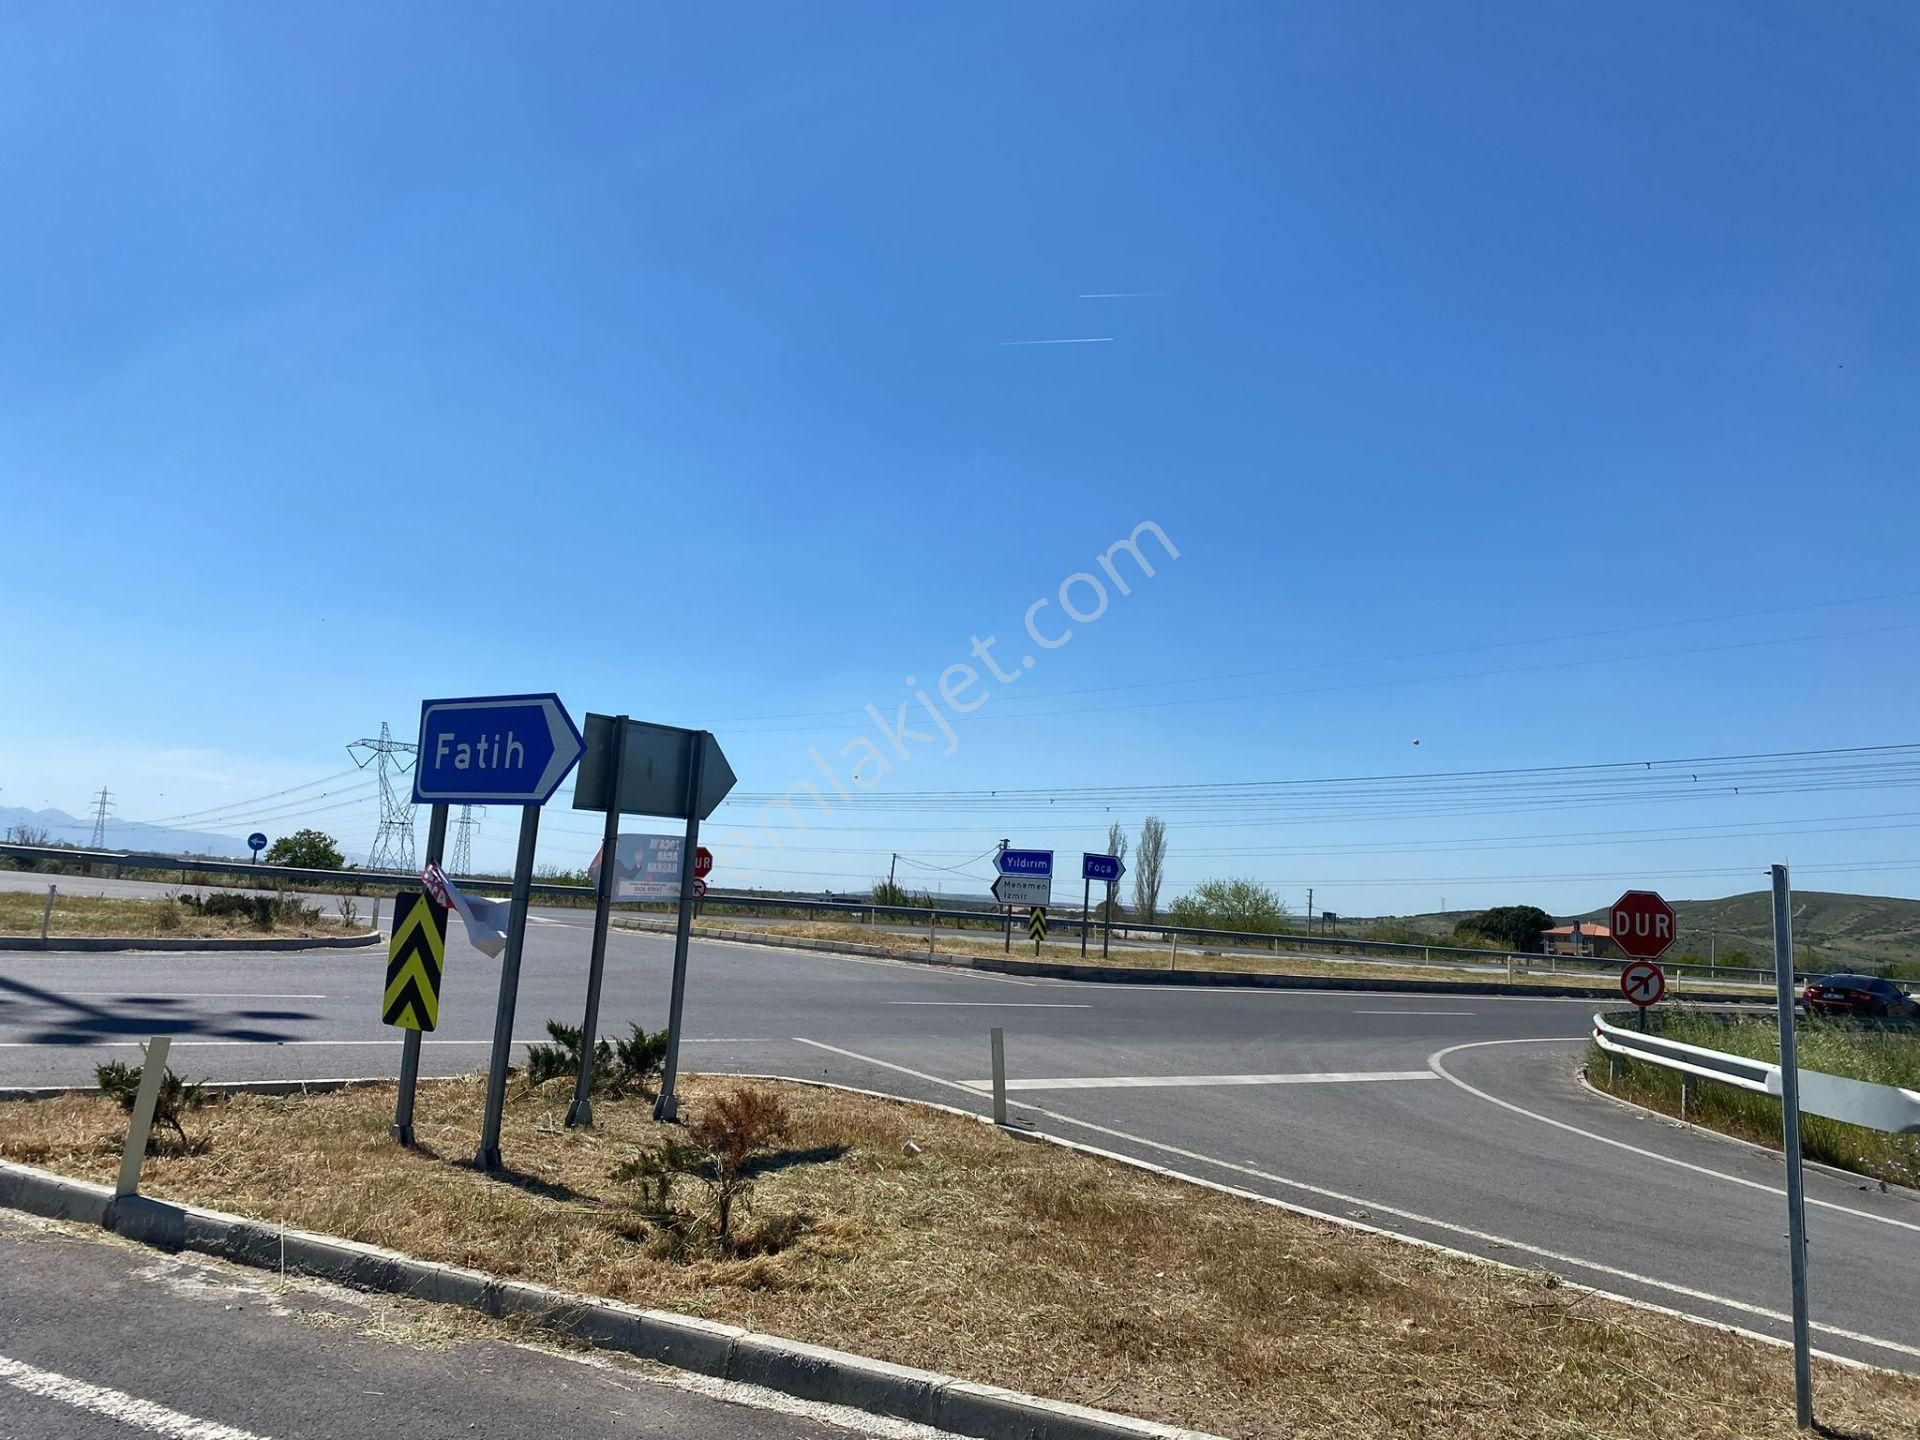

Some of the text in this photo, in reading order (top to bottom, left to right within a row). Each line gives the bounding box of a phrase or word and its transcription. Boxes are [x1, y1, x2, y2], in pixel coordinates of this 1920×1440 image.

[435, 731, 525, 769] Fatih
[695, 857, 710, 869] UR
[1087, 861, 1112, 873] Foça
[1004, 881, 1048, 890] Menemen
[1616, 911, 1670, 938] DUR
